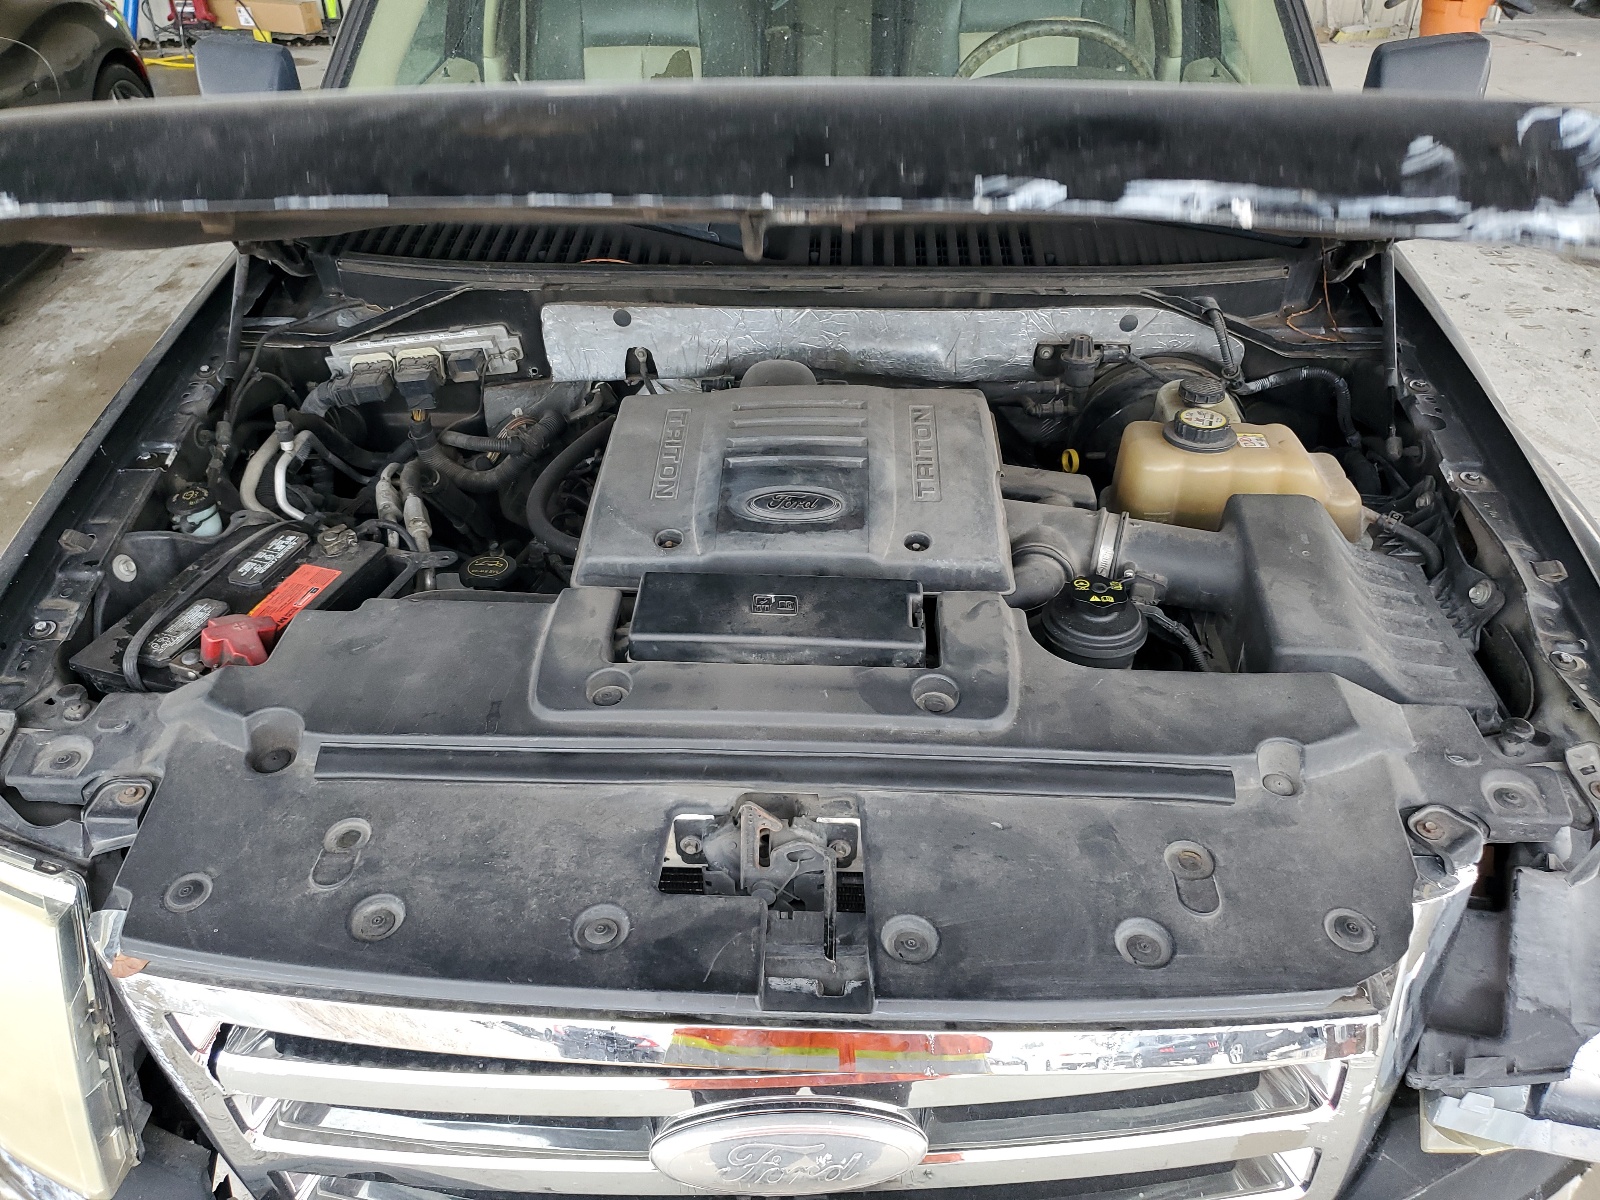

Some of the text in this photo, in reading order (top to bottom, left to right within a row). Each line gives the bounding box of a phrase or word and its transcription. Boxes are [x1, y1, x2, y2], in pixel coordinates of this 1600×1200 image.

[655, 411, 686, 499] TRITON
[912, 408, 936, 499] TRITON
[767, 494, 819, 510] Ford
[717, 1143, 863, 1185] Ford
